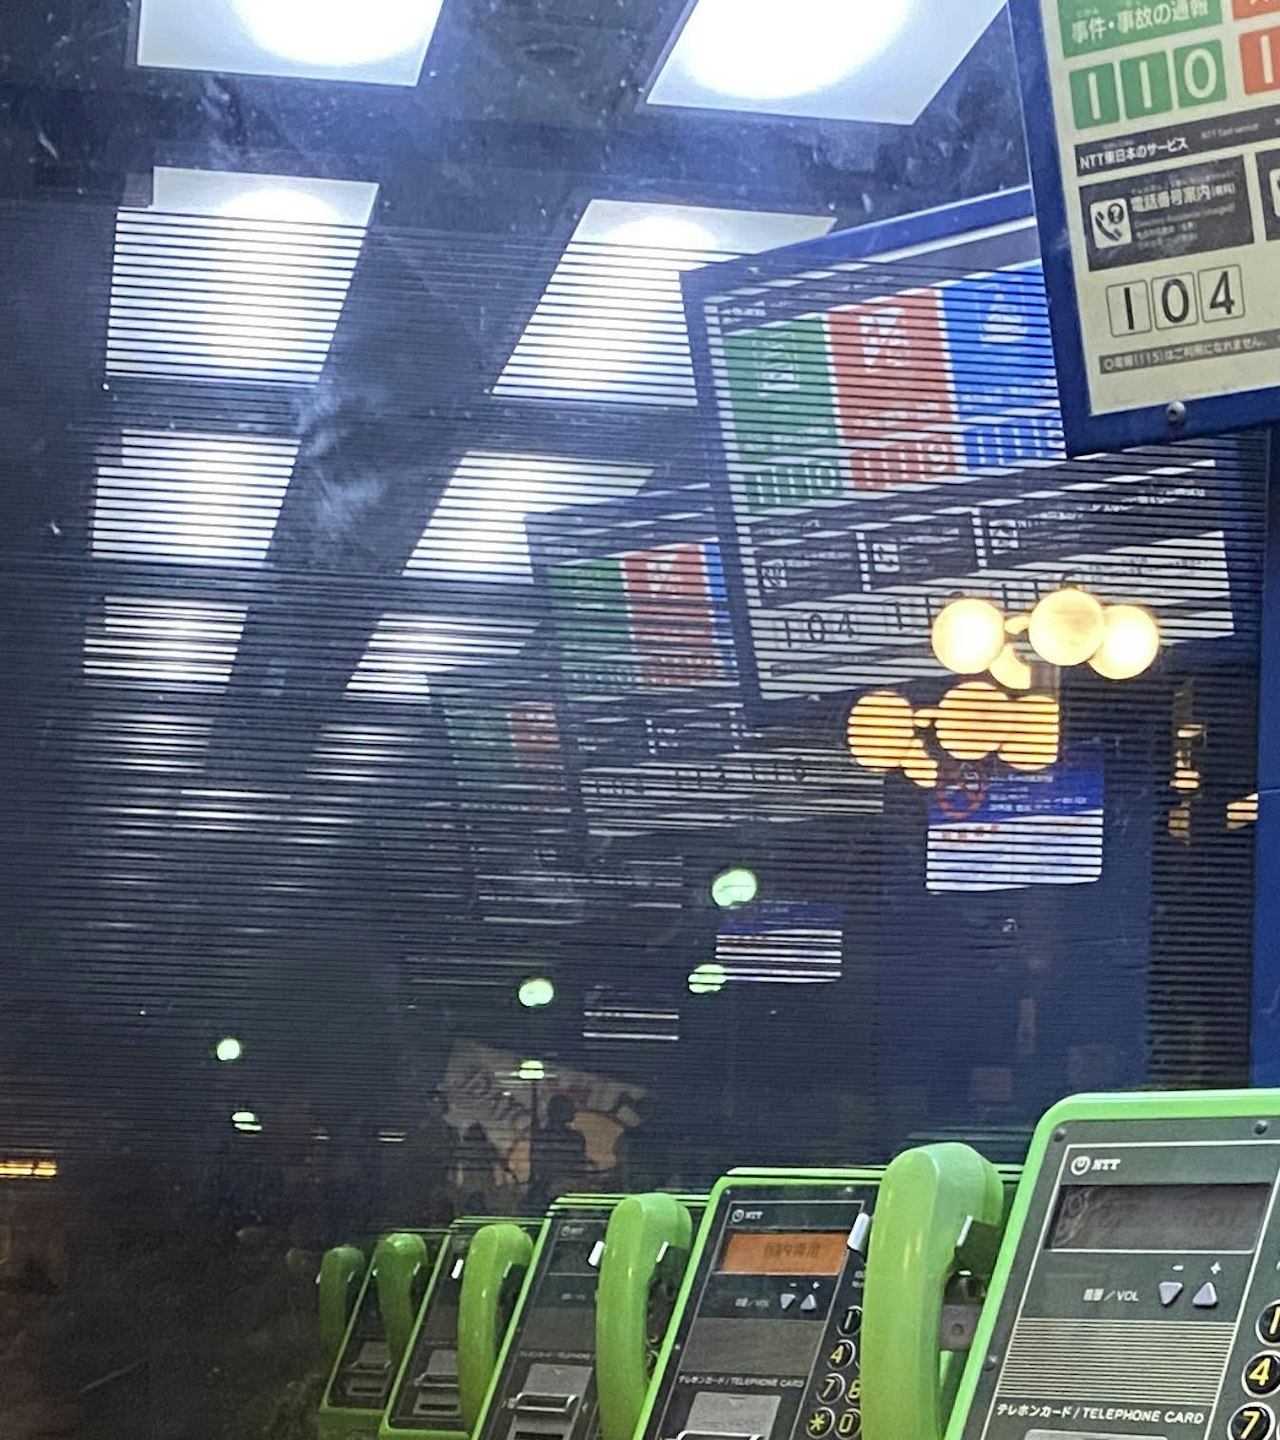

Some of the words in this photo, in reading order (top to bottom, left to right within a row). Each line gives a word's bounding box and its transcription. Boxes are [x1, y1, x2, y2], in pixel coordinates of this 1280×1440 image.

[1088, 48, 1217, 120] 110
[1079, 137, 1188, 169] NTT東日本のサービス
[1124, 270, 1235, 332] 104
[1090, 1158, 1121, 1171] NTT
[830, 1345, 845, 1364] 4
[1249, 1357, 1271, 1386] 4
[838, 1414, 853, 1433] 0
[997, 1404, 1071, 1419] テレホンカード
[1083, 1407, 1161, 1422] TELEPHONE
[1164, 1411, 1205, 1425] CARD
[1240, 1411, 1260, 1440] 7
